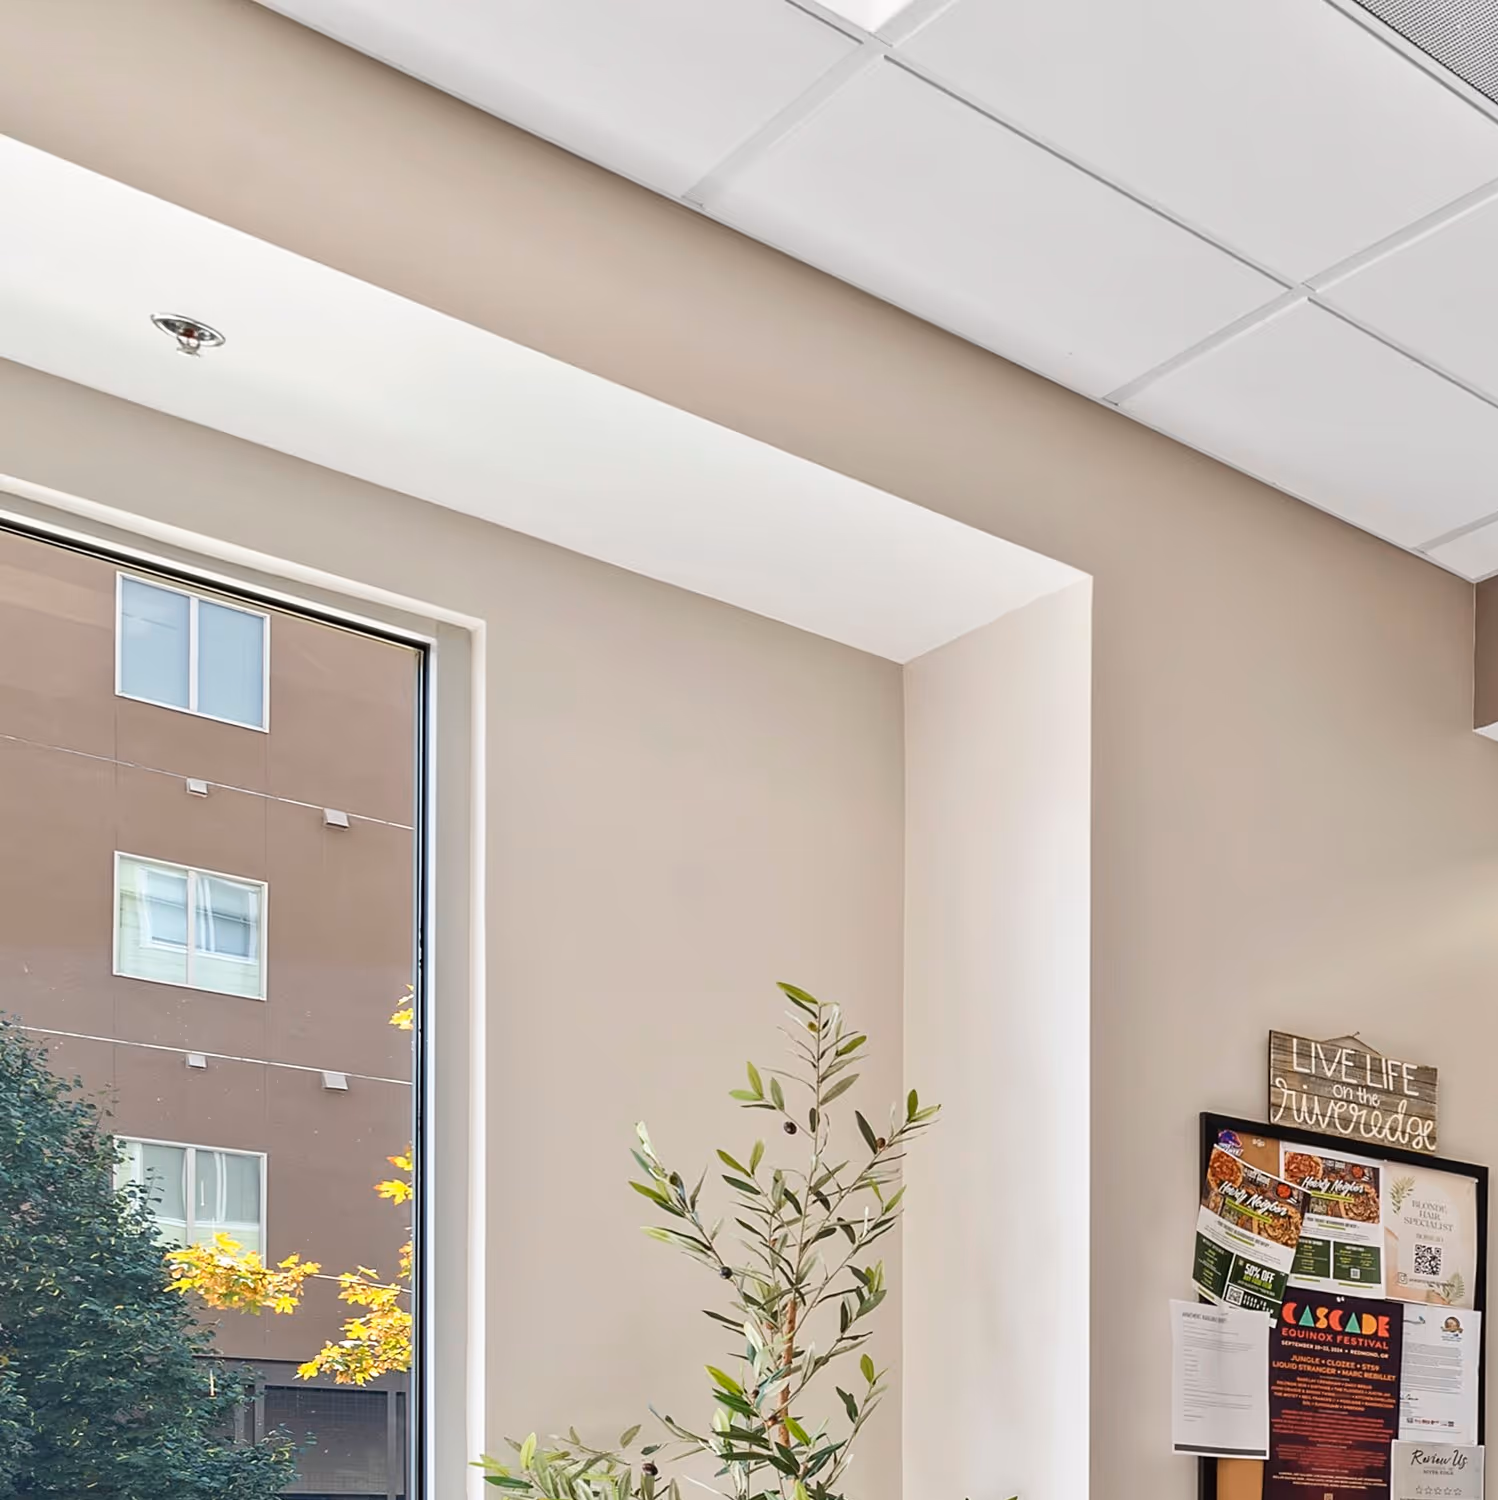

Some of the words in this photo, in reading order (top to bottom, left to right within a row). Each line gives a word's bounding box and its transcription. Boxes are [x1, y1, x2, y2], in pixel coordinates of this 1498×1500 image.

[1292, 1038, 1358, 1084] LIVE
[1366, 1054, 1420, 1096] LIFE
[1333, 1084, 1353, 1099] on
[1356, 1087, 1380, 1107] the
[1271, 1077, 1437, 1150] riveredge
[1404, 1217, 1454, 1231] SPECIALIST
[1244, 1264, 1261, 1278] 50%
[1261, 1270, 1275, 1283] OFF
[1282, 1302, 1390, 1337] CASCADE
[1282, 1328, 1333, 1342] EQUINOX
[1337, 1336, 1389, 1349] FESTIVAL
[1272, 1361, 1297, 1370] LIQUID
[1298, 1365, 1336, 1375] STRANGER
[1291, 1354, 1320, 1363] JUNGLE
[1410, 1449, 1451, 1466] Review
[1452, 1449, 1468, 1470] Us
